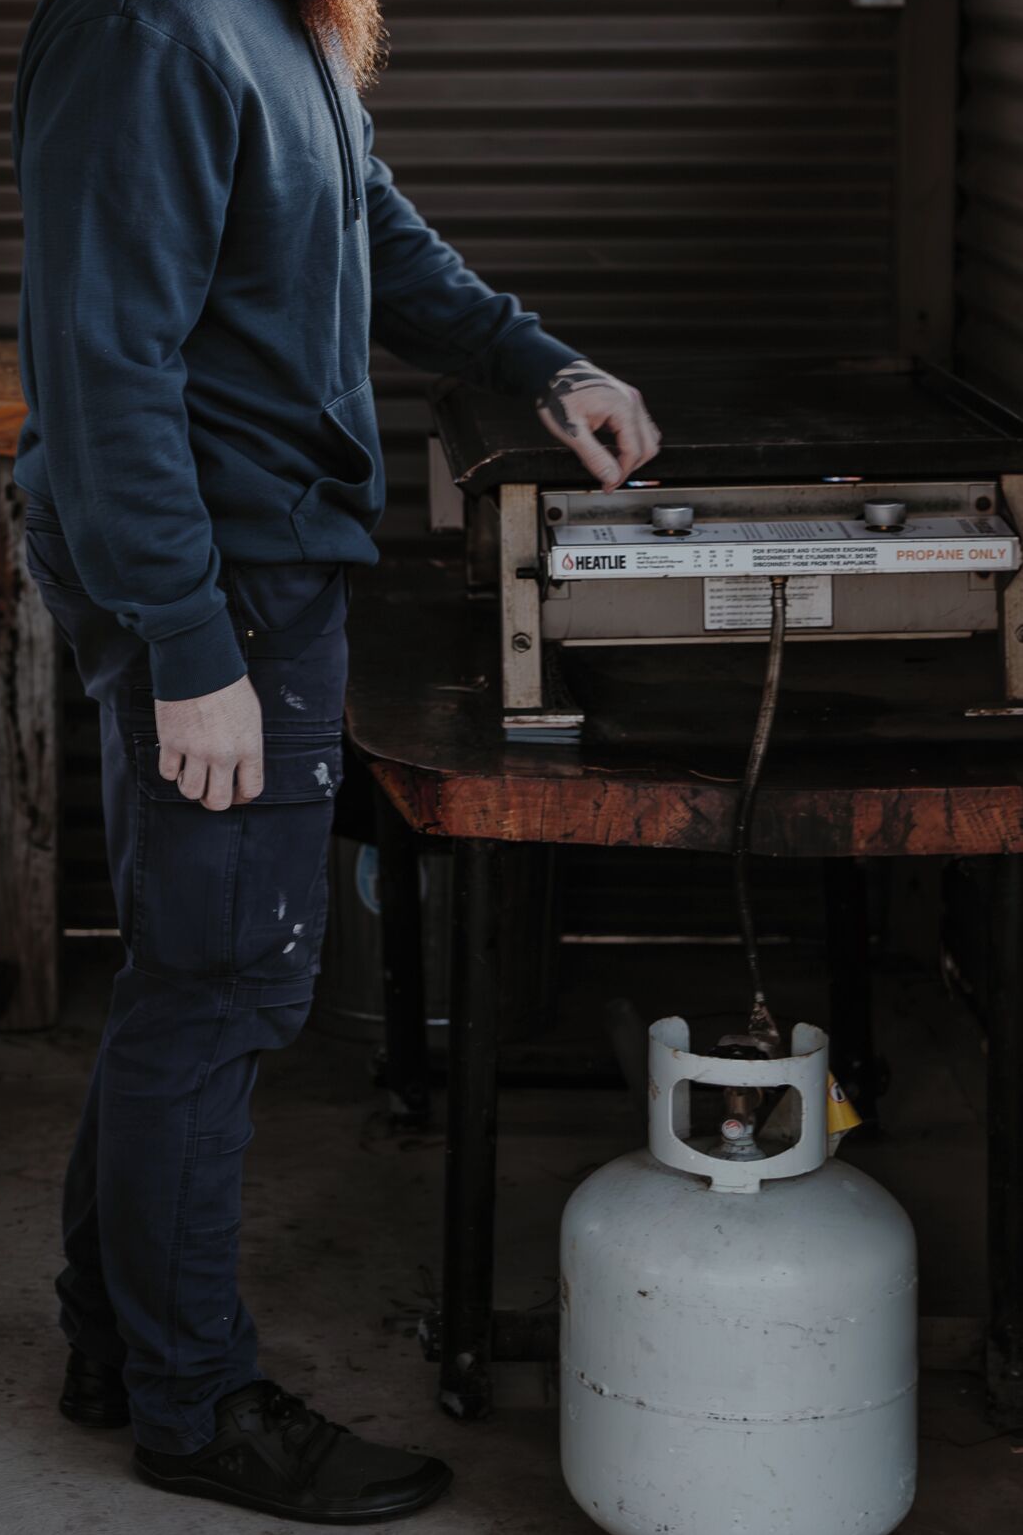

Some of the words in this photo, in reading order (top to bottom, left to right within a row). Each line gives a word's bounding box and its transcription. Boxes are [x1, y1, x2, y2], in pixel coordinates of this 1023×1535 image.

[896, 549, 965, 561] PROPANE
[968, 548, 1007, 560] ONLY
[576, 555, 626, 570] HEATLIE
